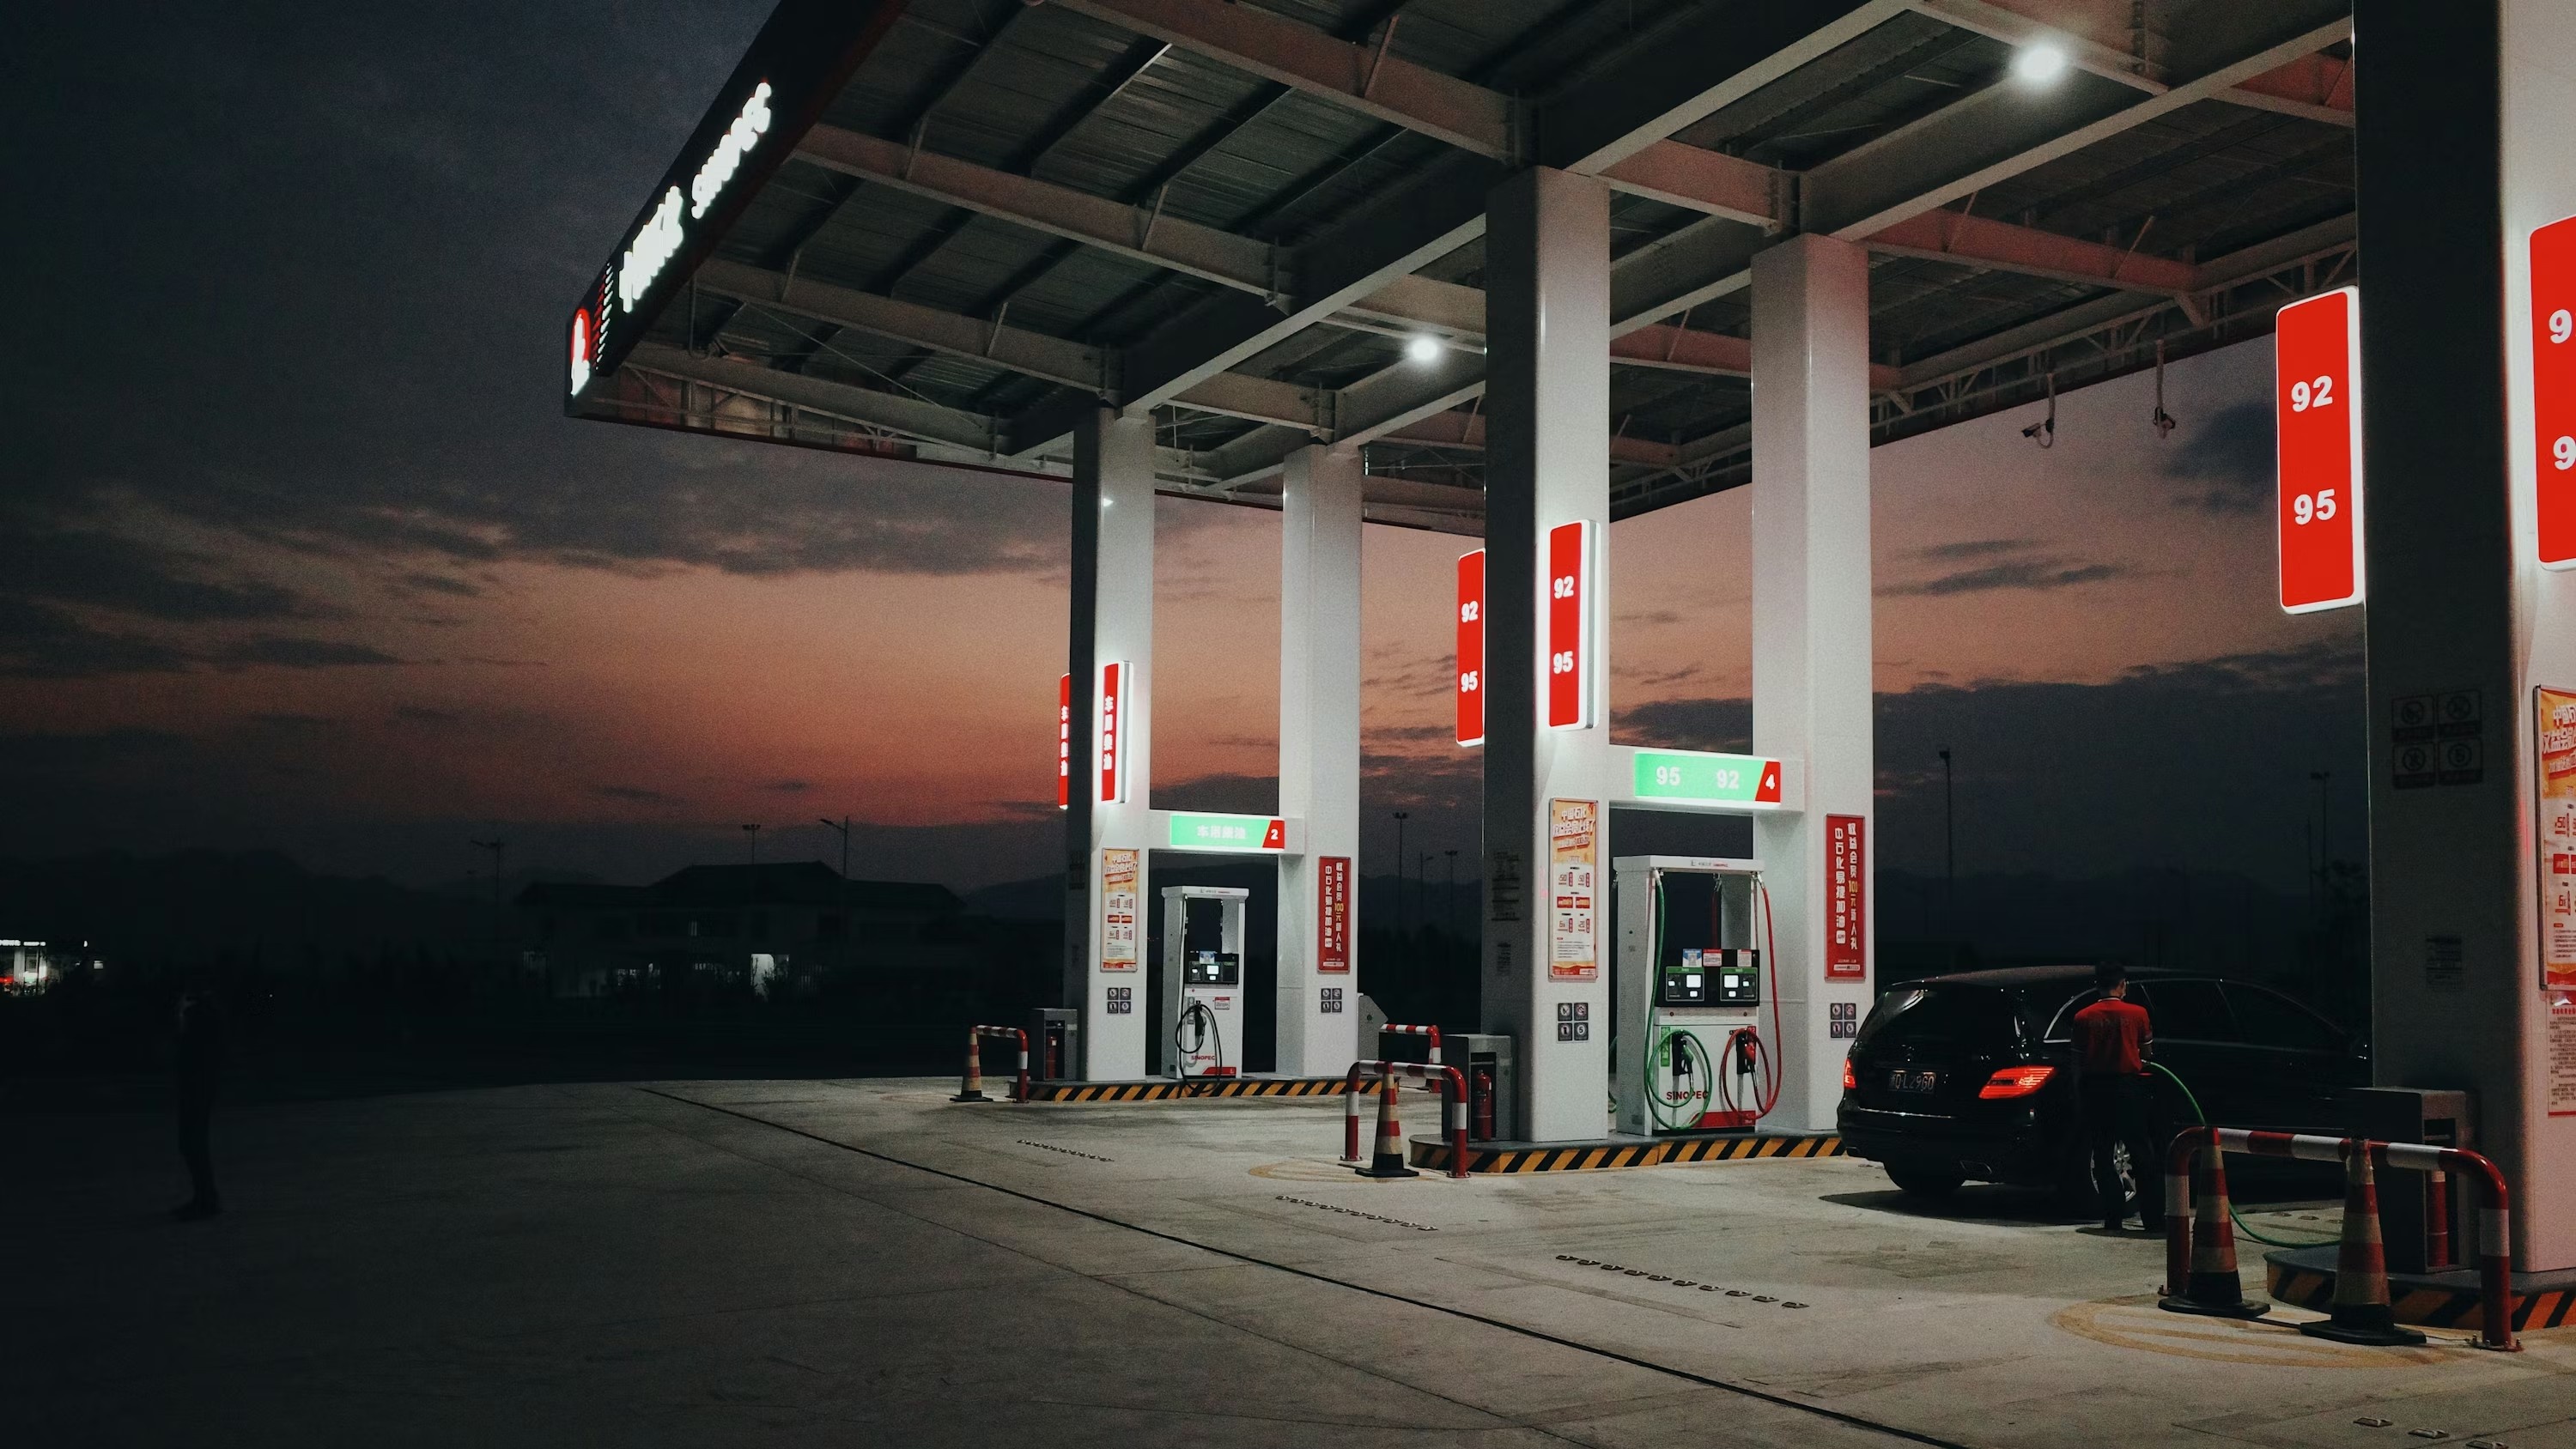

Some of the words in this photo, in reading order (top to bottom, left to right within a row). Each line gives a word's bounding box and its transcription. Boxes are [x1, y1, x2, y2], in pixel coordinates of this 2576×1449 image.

[2549, 309, 2576, 344] 9
[2291, 375, 2333, 412] 92
[2293, 488, 2336, 525] 95
[1554, 575, 1574, 599] 92
[1461, 601, 1479, 623] 92
[1553, 651, 1573, 675] 95
[1461, 670, 1478, 693] 95
[1656, 766, 1681, 785] 95
[1716, 769, 1741, 790] 92
[1765, 773, 1775, 790] 4
[1271, 829, 1279, 840] 2
